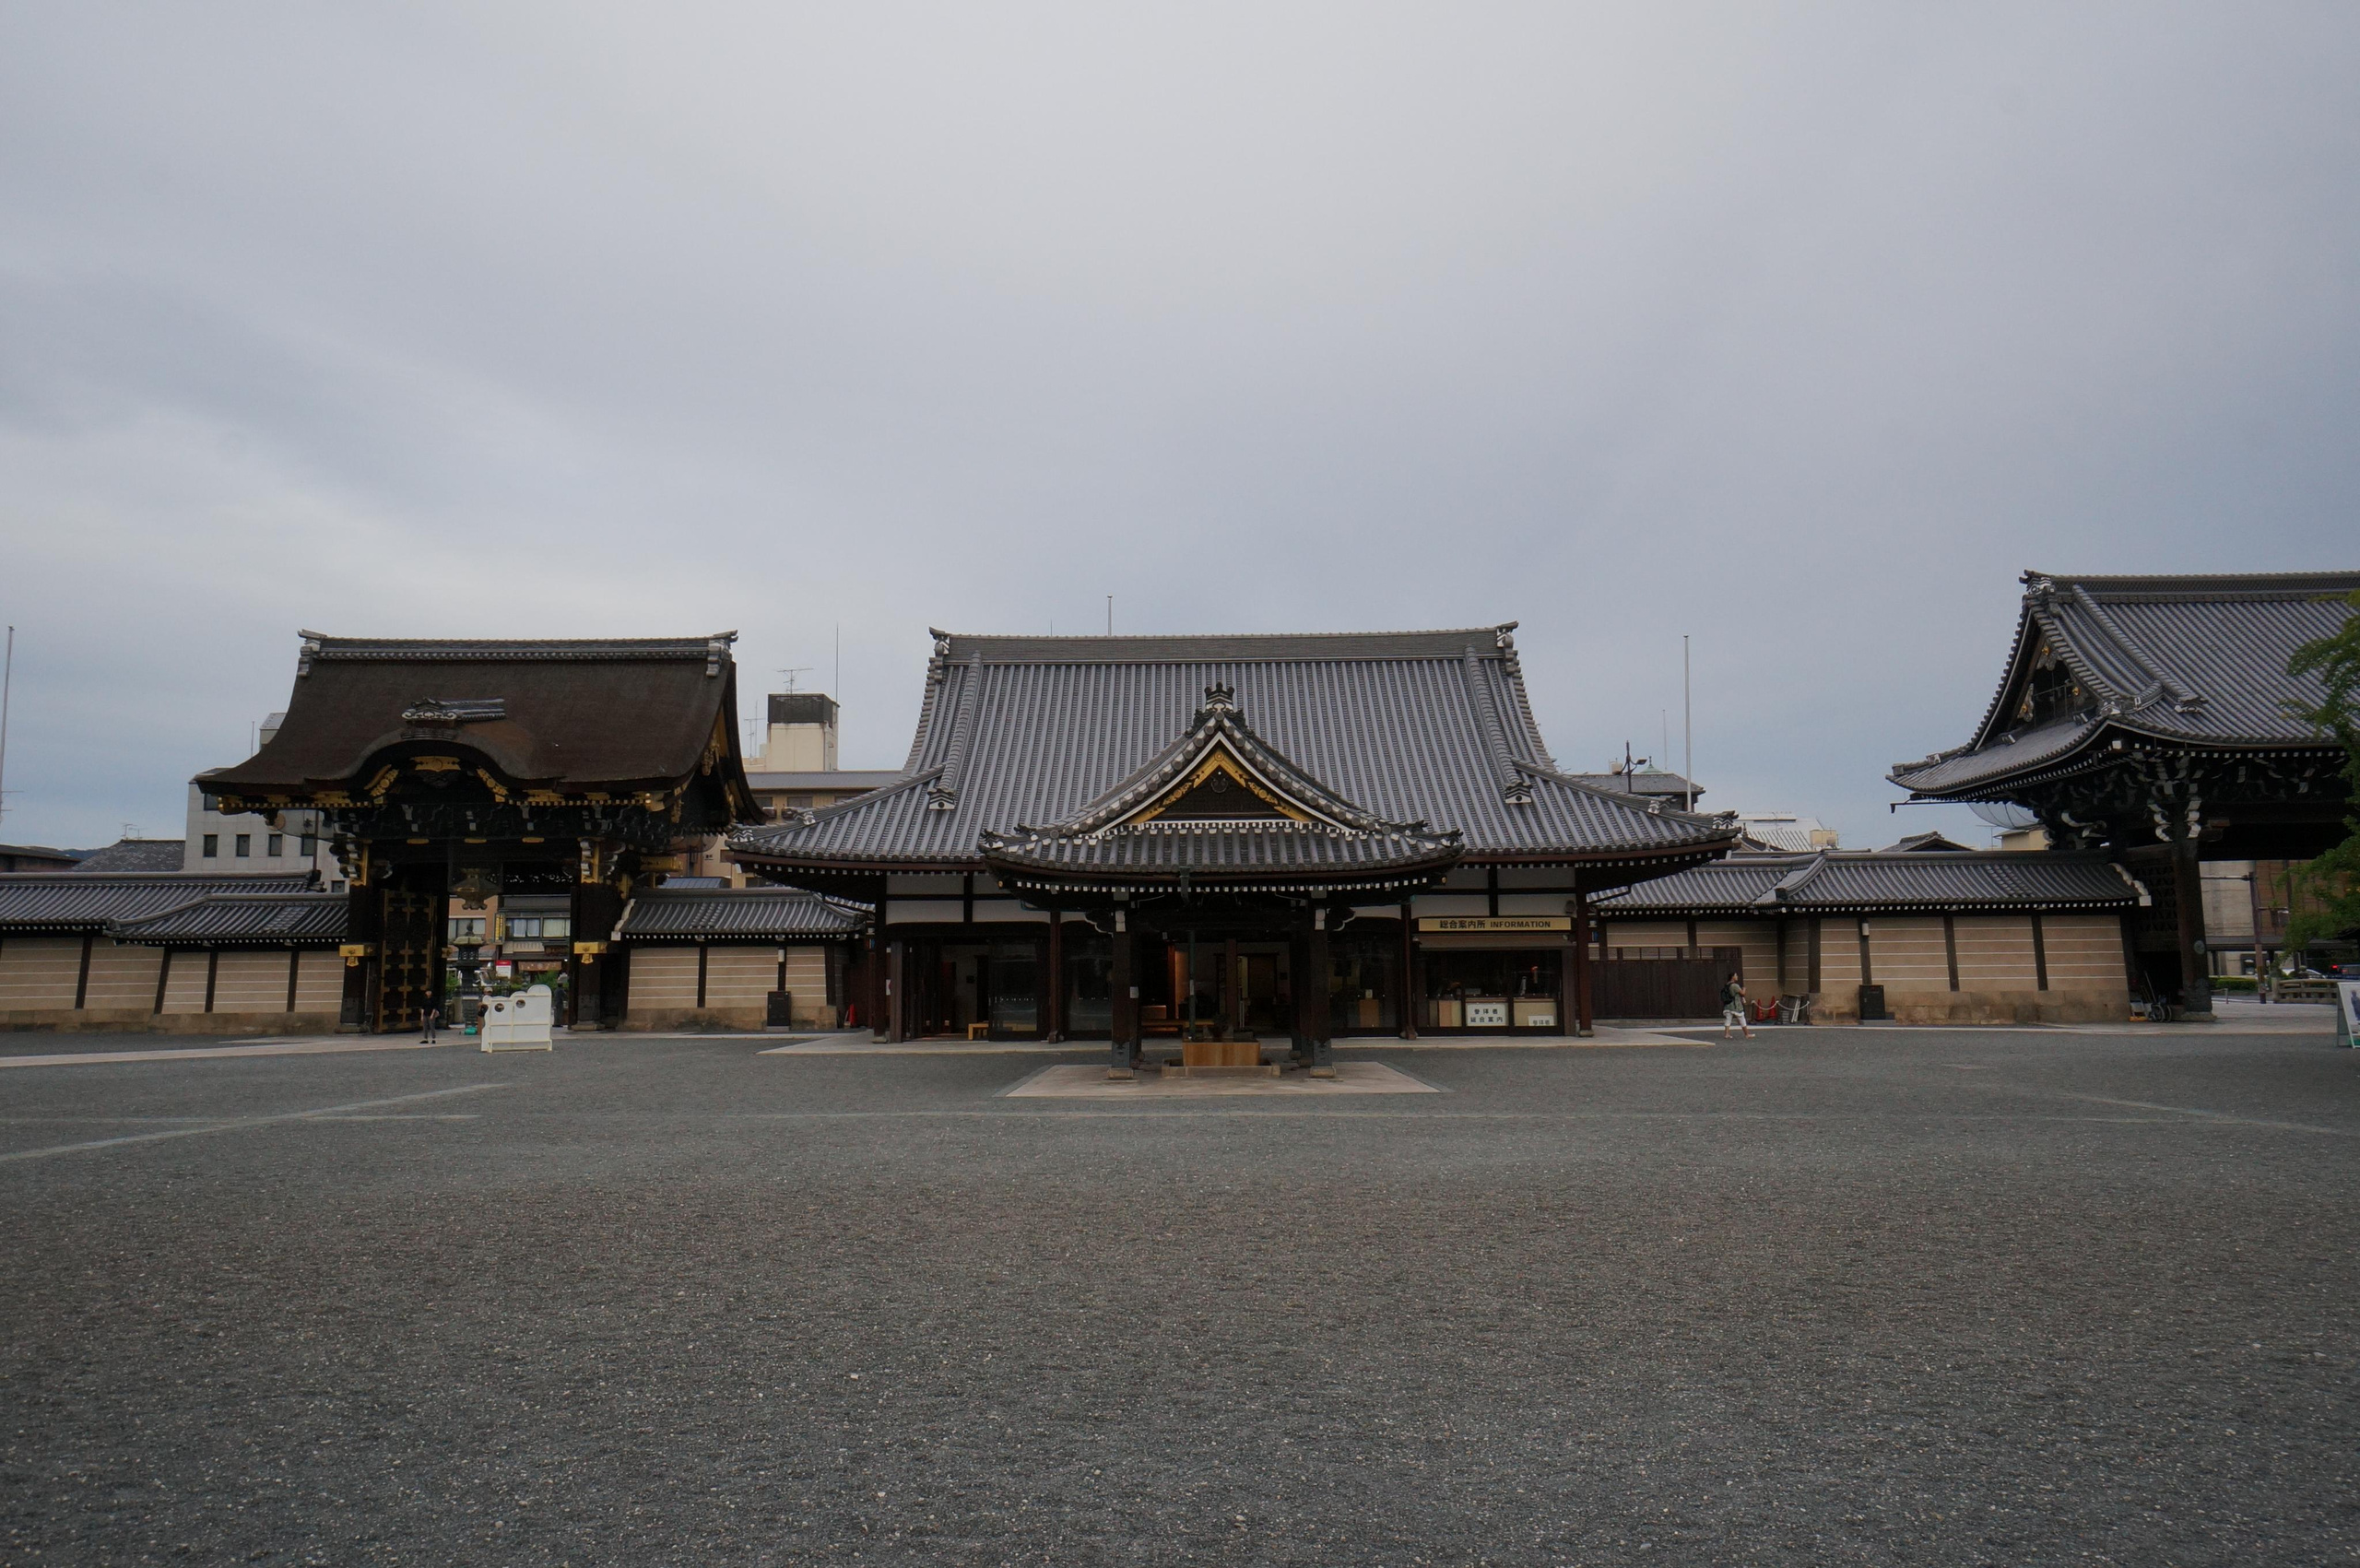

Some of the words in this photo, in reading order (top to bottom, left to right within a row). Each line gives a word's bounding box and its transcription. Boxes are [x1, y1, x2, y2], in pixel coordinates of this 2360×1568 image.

[1440, 920, 1485, 928] 総合案内所
